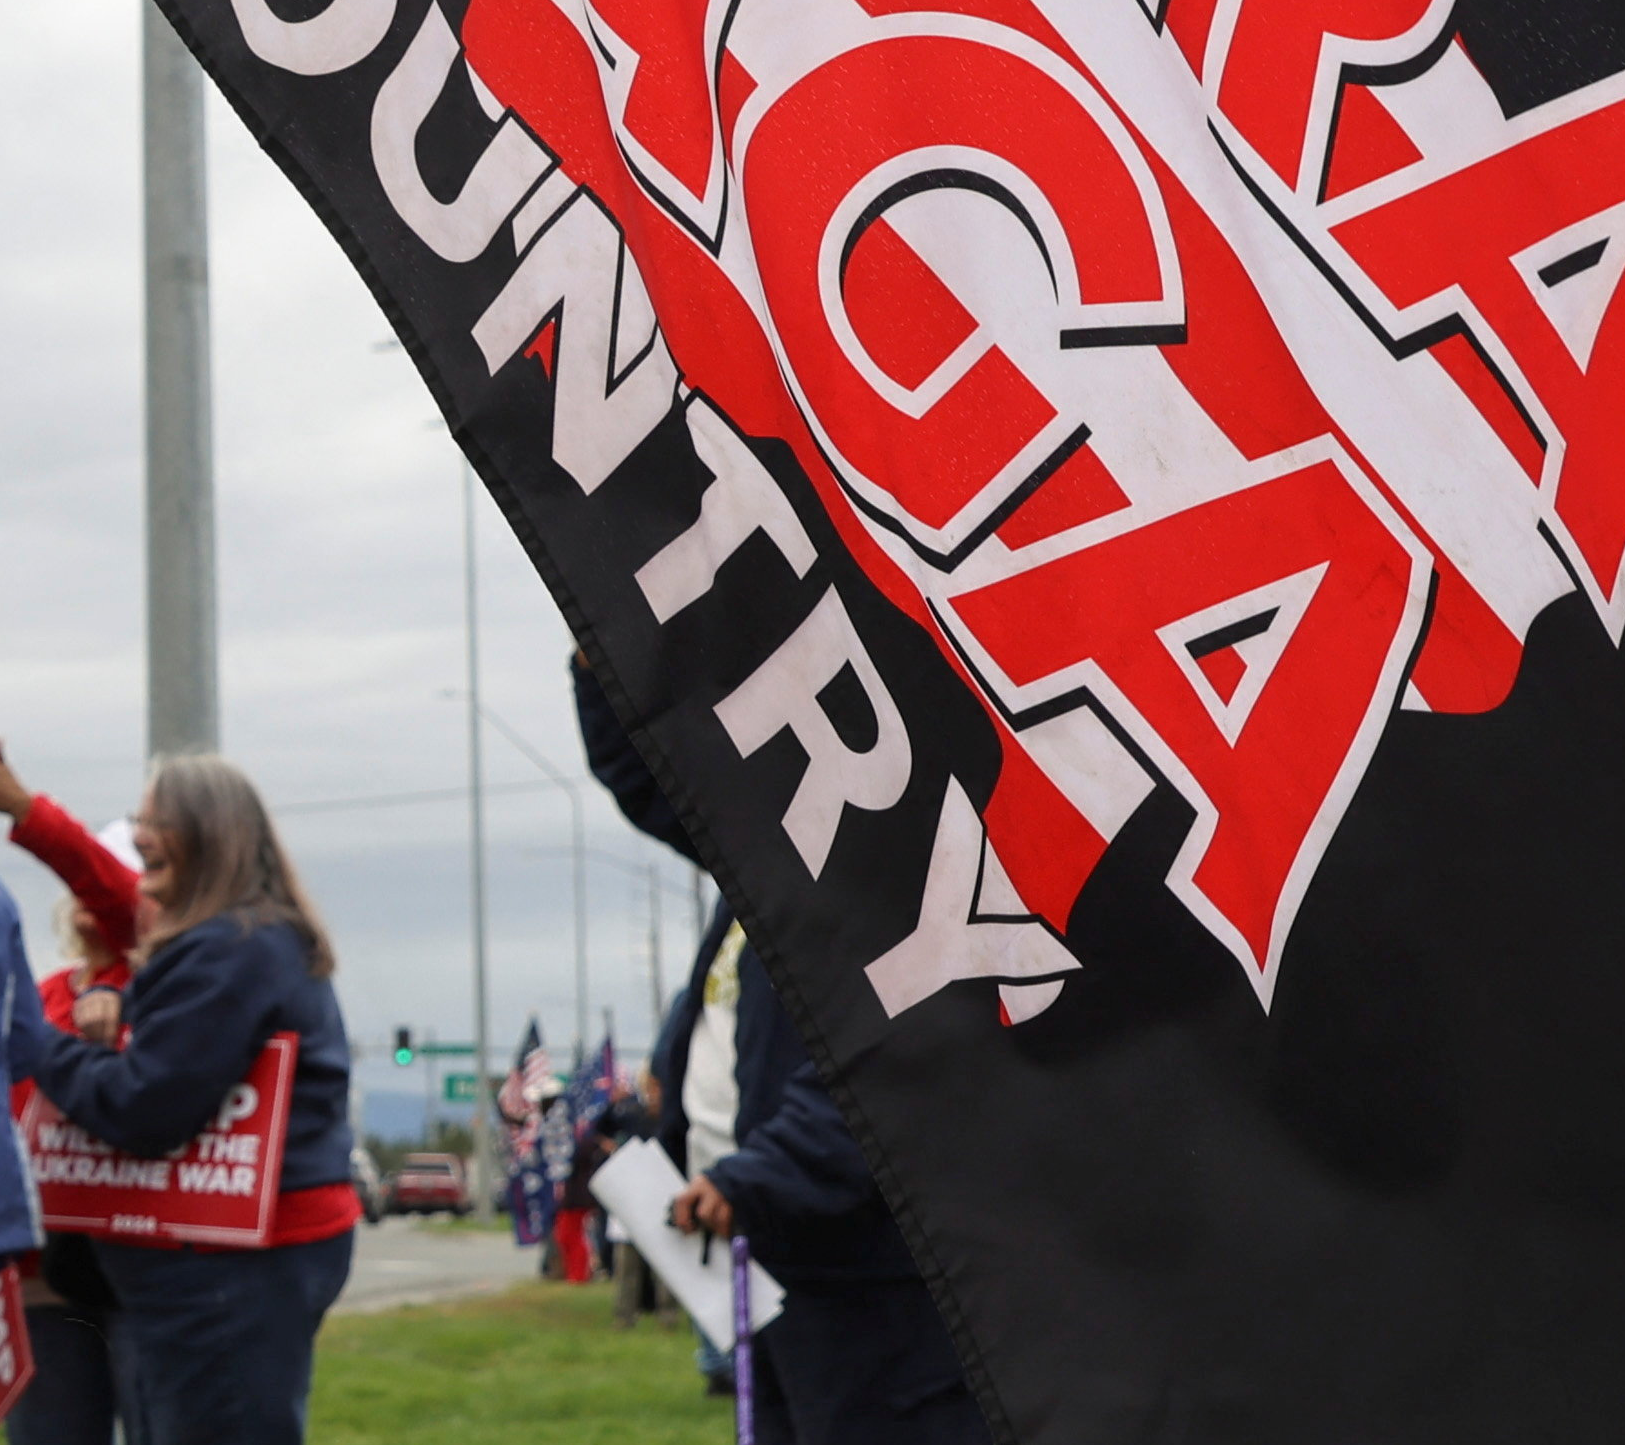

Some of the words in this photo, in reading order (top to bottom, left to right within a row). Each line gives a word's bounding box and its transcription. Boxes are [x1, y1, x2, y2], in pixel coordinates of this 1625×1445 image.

[37, 1122, 113, 1154] WIL
[197, 1133, 261, 1166] THE
[177, 1162, 257, 1197] WAR
